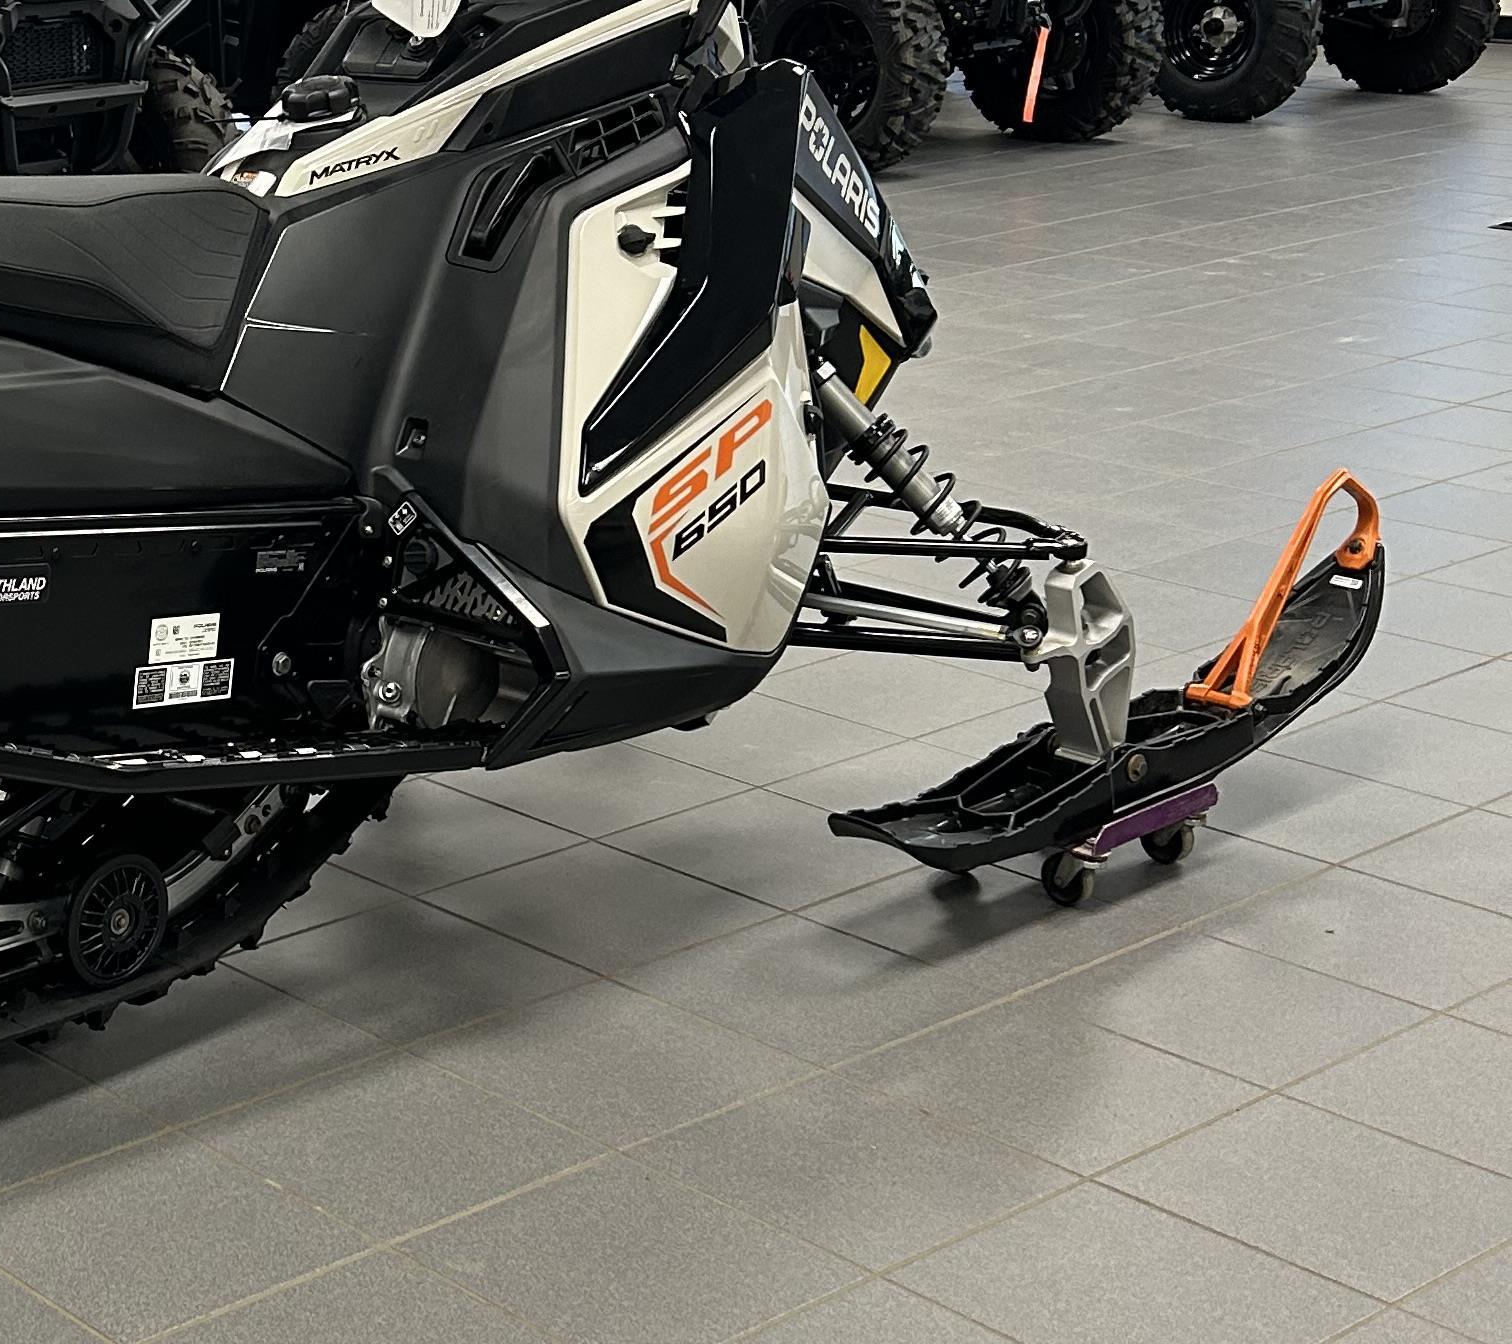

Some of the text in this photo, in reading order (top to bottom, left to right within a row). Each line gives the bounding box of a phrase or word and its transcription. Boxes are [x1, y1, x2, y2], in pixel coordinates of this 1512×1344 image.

[309, 146, 401, 185] MATRYX
[799, 93, 881, 238] POLARIS
[648, 399, 773, 535] SP
[672, 458, 766, 562] 650
